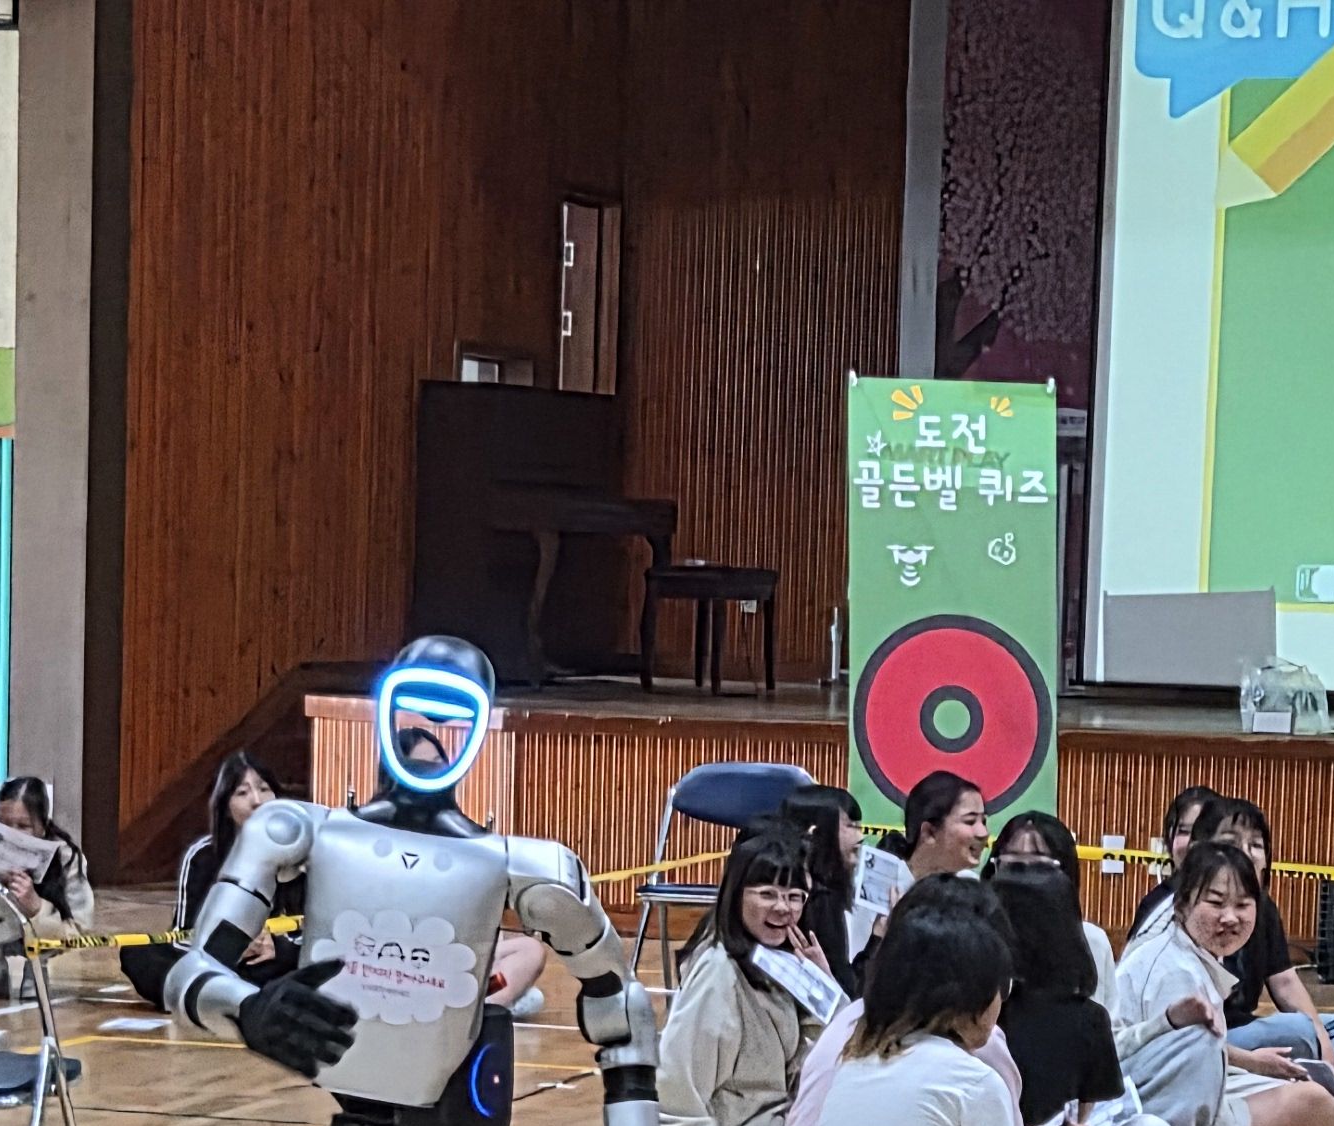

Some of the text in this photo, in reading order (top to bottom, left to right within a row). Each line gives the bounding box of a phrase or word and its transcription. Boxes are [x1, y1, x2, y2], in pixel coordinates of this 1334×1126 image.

[915, 413, 987, 454] 도전
[853, 460, 1049, 511] 골든벨 퀴즈
